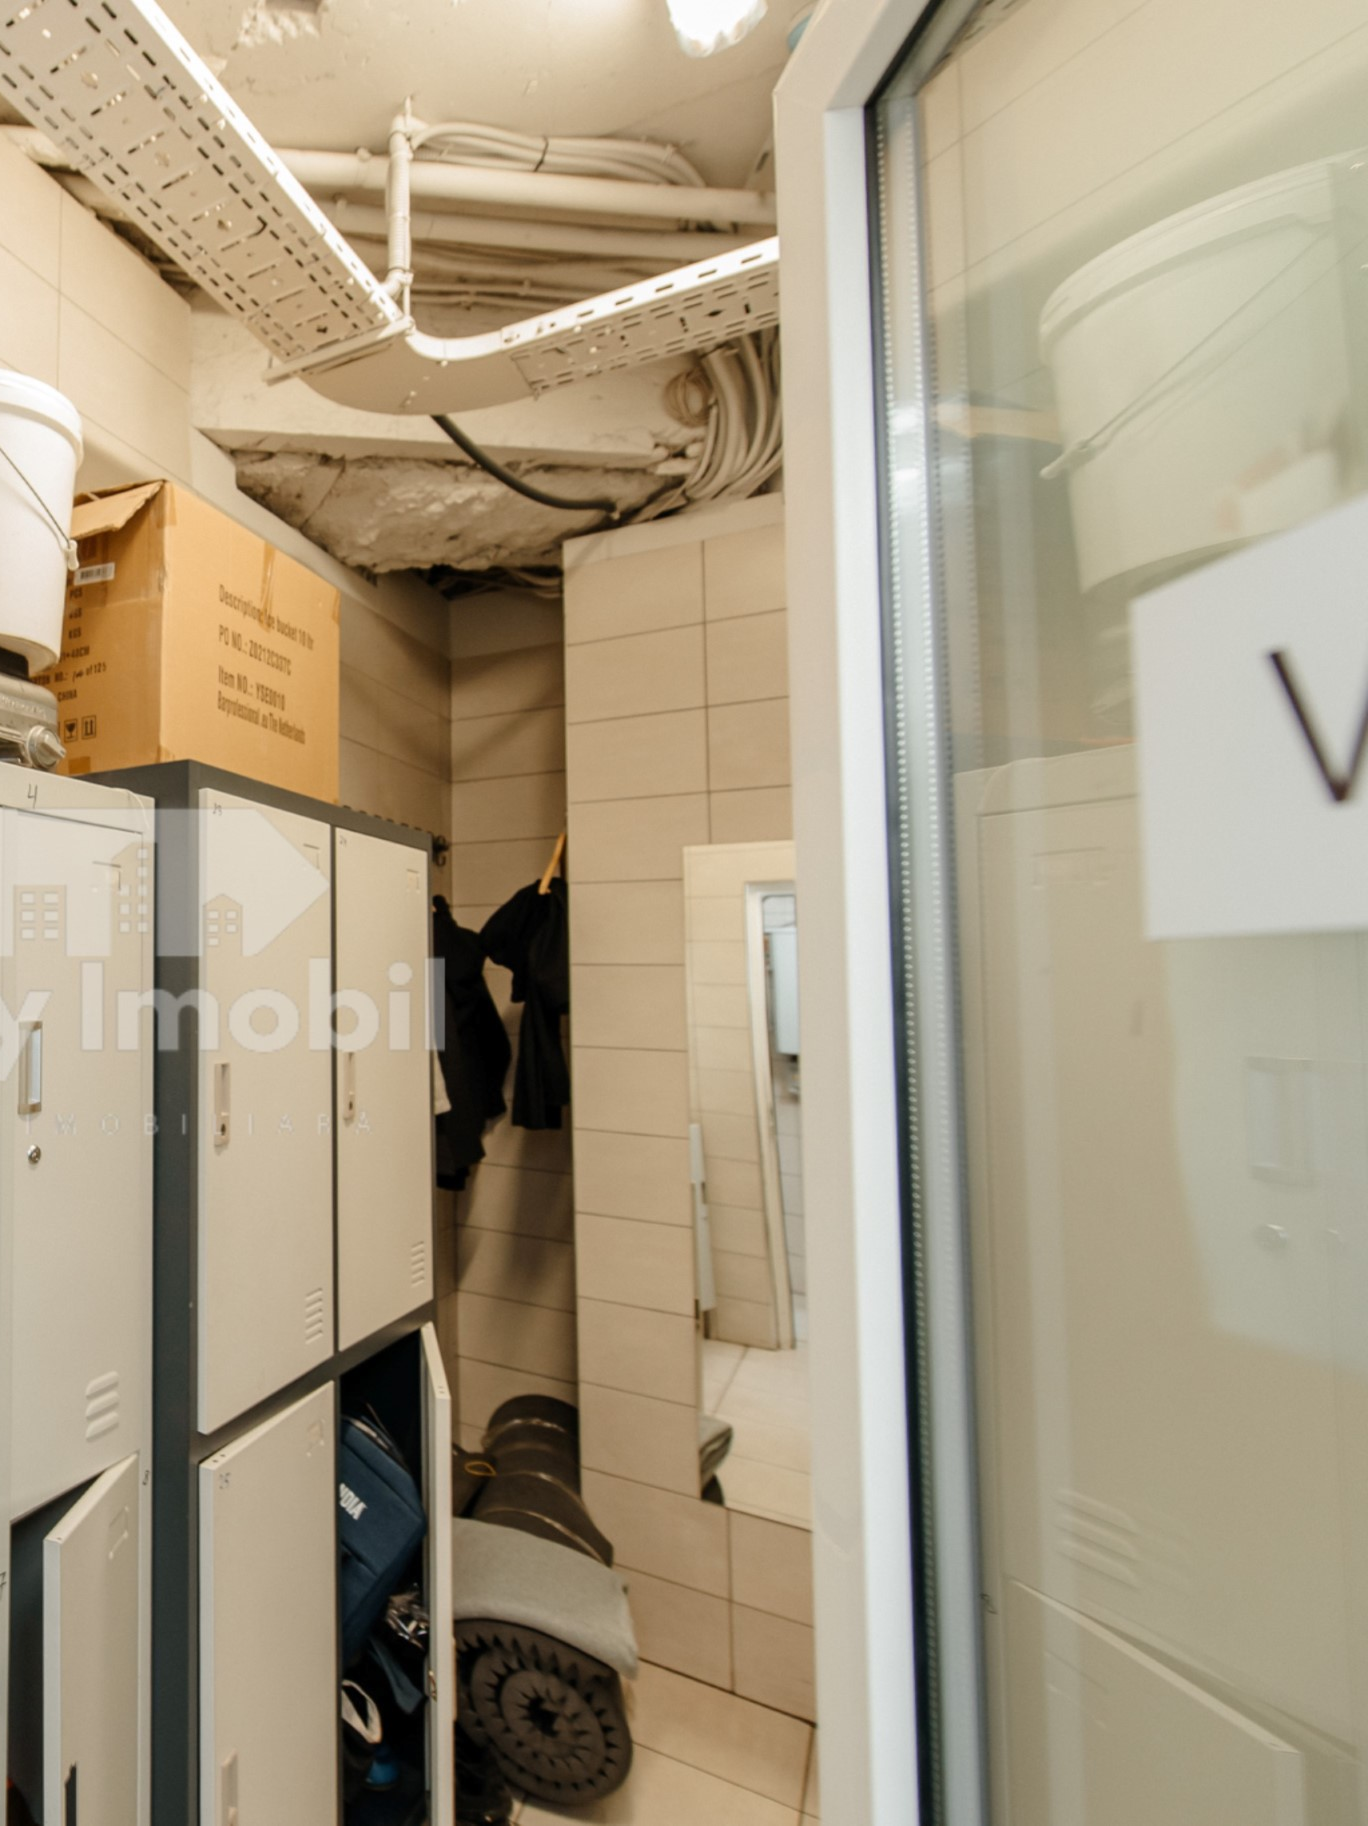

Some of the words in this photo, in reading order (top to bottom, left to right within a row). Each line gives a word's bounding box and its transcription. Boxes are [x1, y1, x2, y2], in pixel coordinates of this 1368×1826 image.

[219, 624, 229, 646] PO
[218, 665, 235, 689] Item
[27, 783, 38, 809] 4
